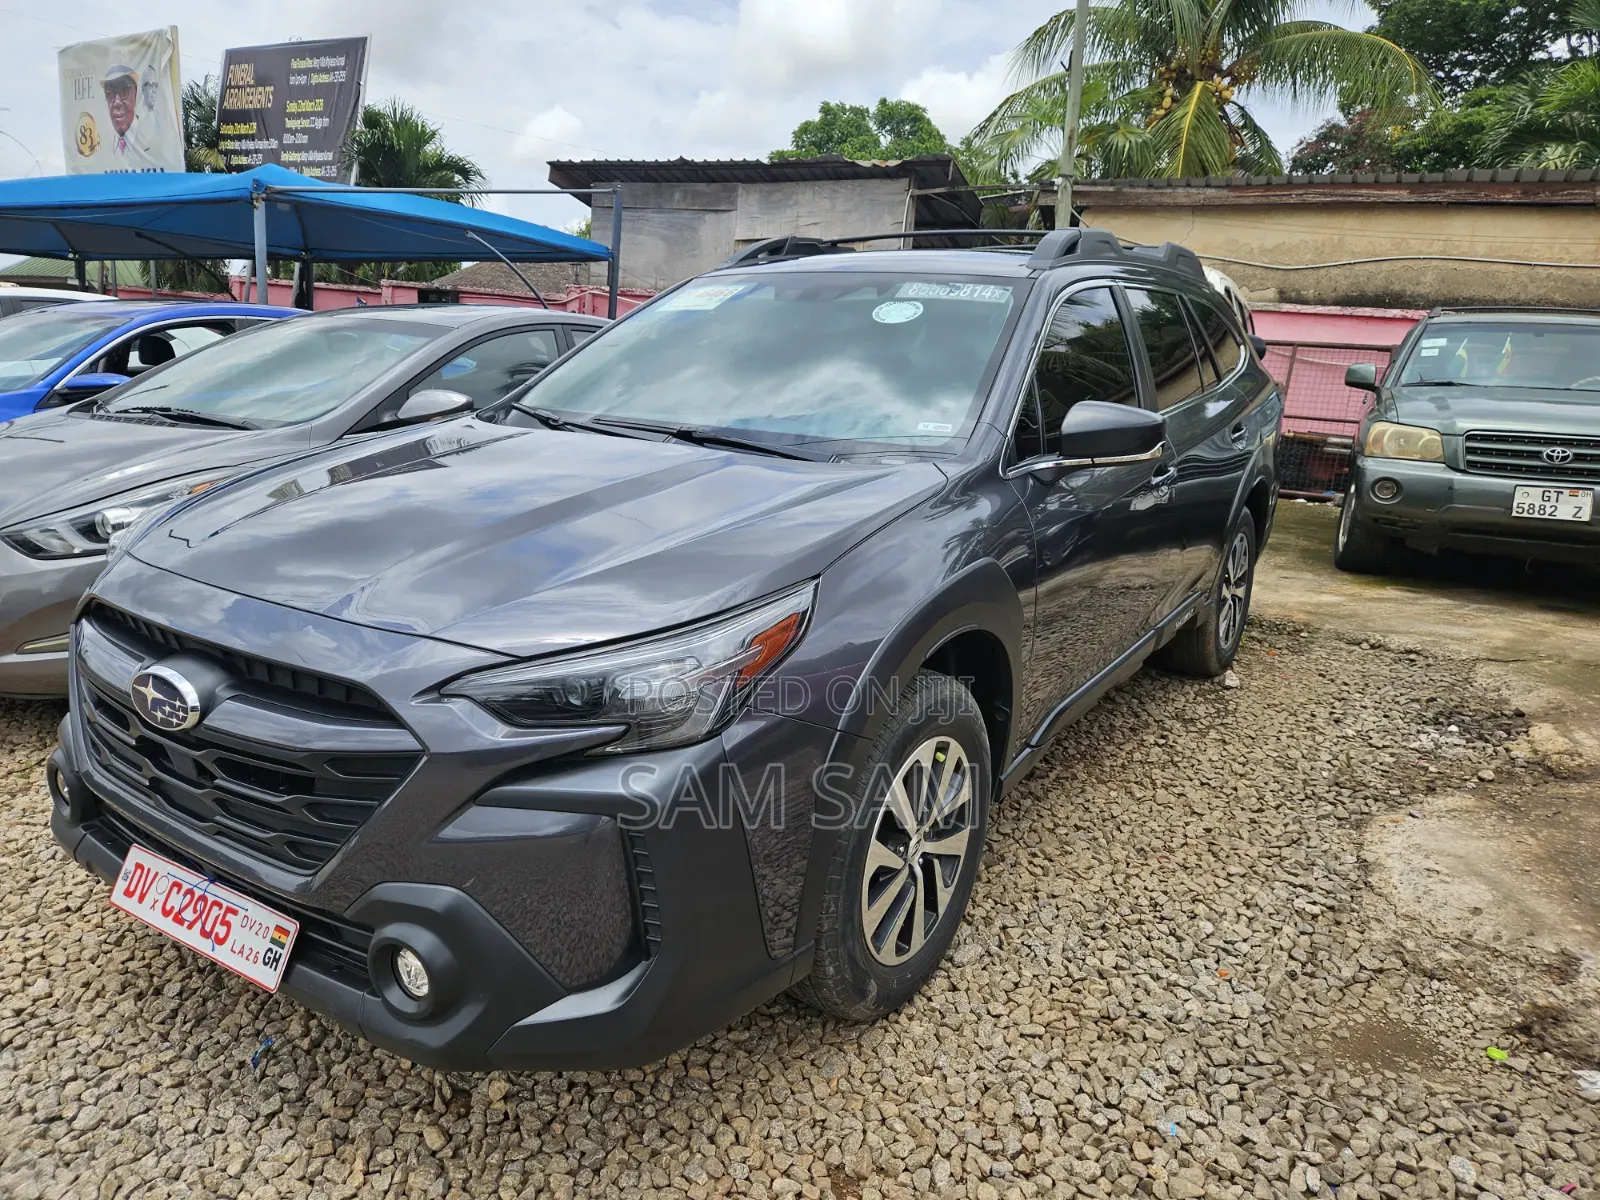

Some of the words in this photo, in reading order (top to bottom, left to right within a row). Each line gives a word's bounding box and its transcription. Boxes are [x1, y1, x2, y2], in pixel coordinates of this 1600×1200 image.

[227, 62, 254, 86] FUNERAL
[74, 77, 95, 101] LIFE
[222, 85, 274, 110] ARRANGEMENTS
[79, 125, 93, 148] 83
[1541, 489, 1564, 503] GT
[1515, 502, 1558, 518] 5882
[1571, 505, 1583, 519] Z
[123, 862, 159, 904] DV
[240, 914, 270, 940] DV20
[230, 938, 260, 965] LA26
[262, 946, 283, 972] GH
